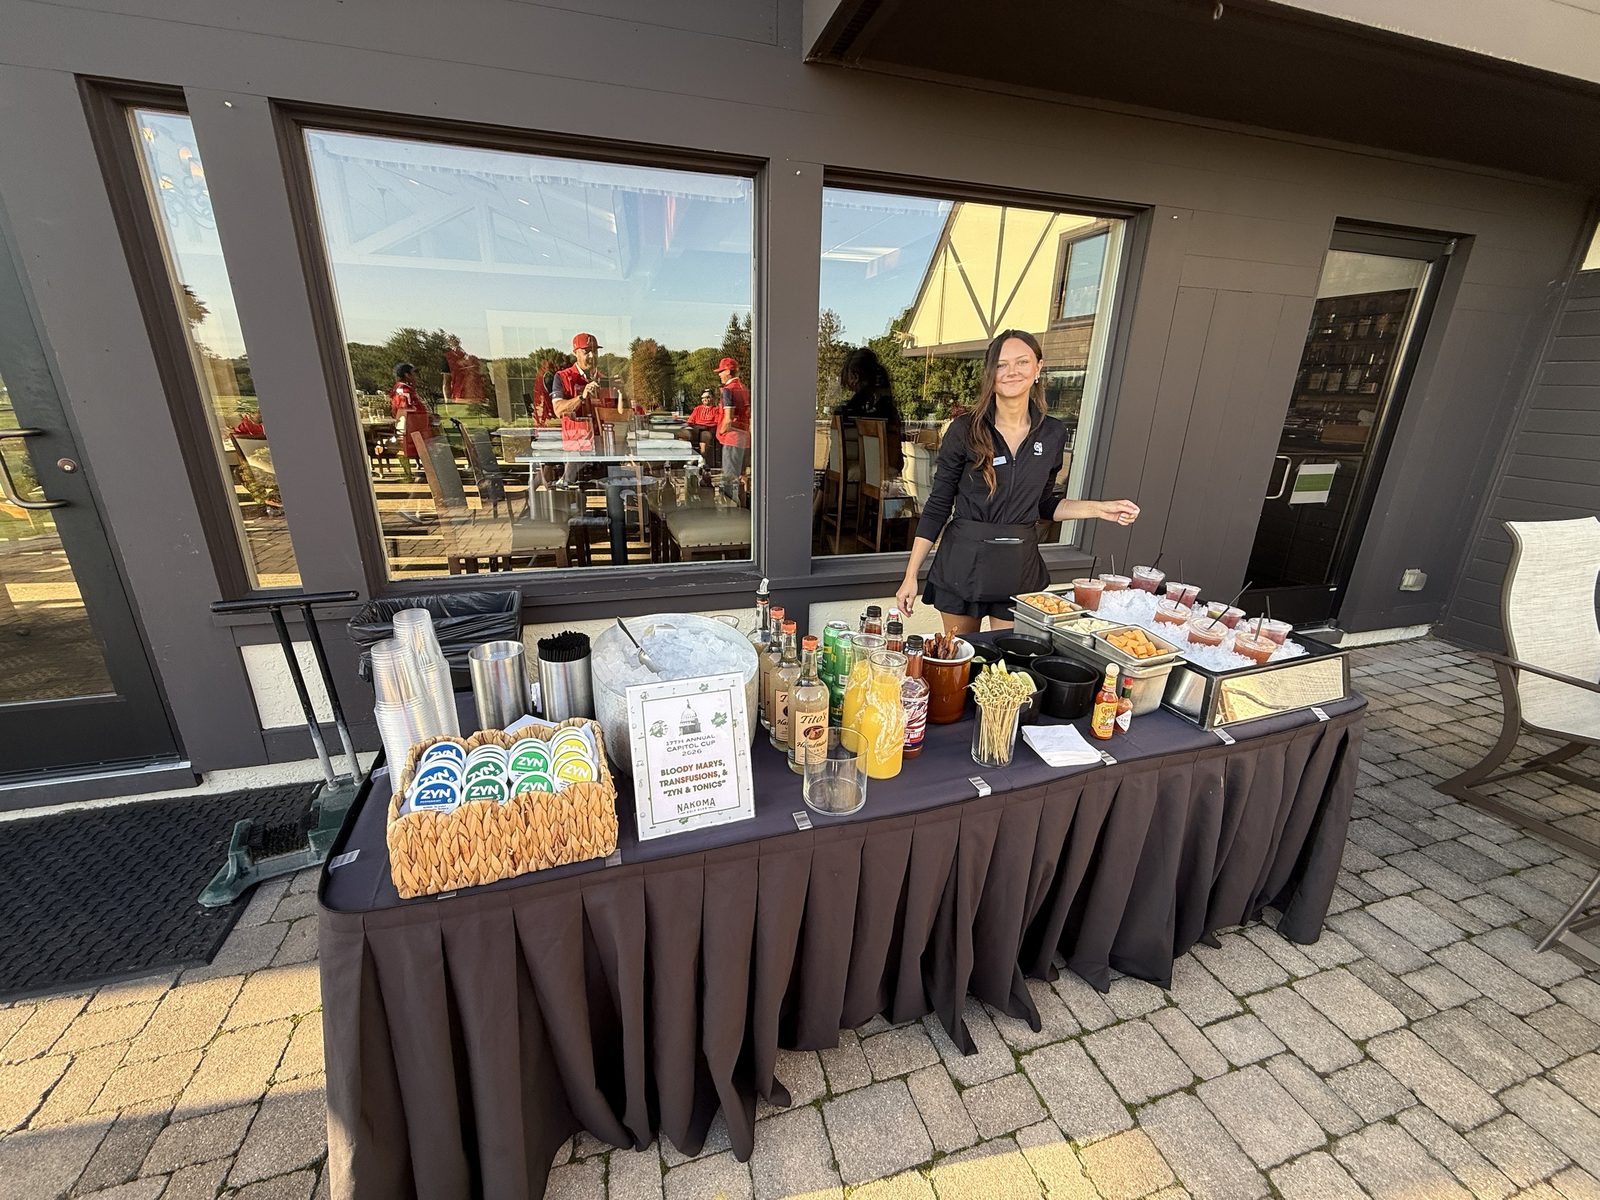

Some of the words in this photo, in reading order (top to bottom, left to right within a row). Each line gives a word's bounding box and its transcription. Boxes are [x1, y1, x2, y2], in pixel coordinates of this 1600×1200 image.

[685, 734, 716, 743] ANNUAL
[666, 743, 699, 753] CAPITOL
[517, 757, 544, 768] ZYN
[661, 764, 693, 776] BLOODY
[695, 759, 726, 770] MARYS,
[564, 764, 589, 779] ZYN
[659, 771, 720, 787] TRANSFUSIONS,
[470, 784, 499, 796] ZYN
[520, 781, 548, 792] ZYN
[685, 786, 691, 794] &
[420, 788, 451, 800] ZYN
[677, 797, 716, 813] NAKOMA
